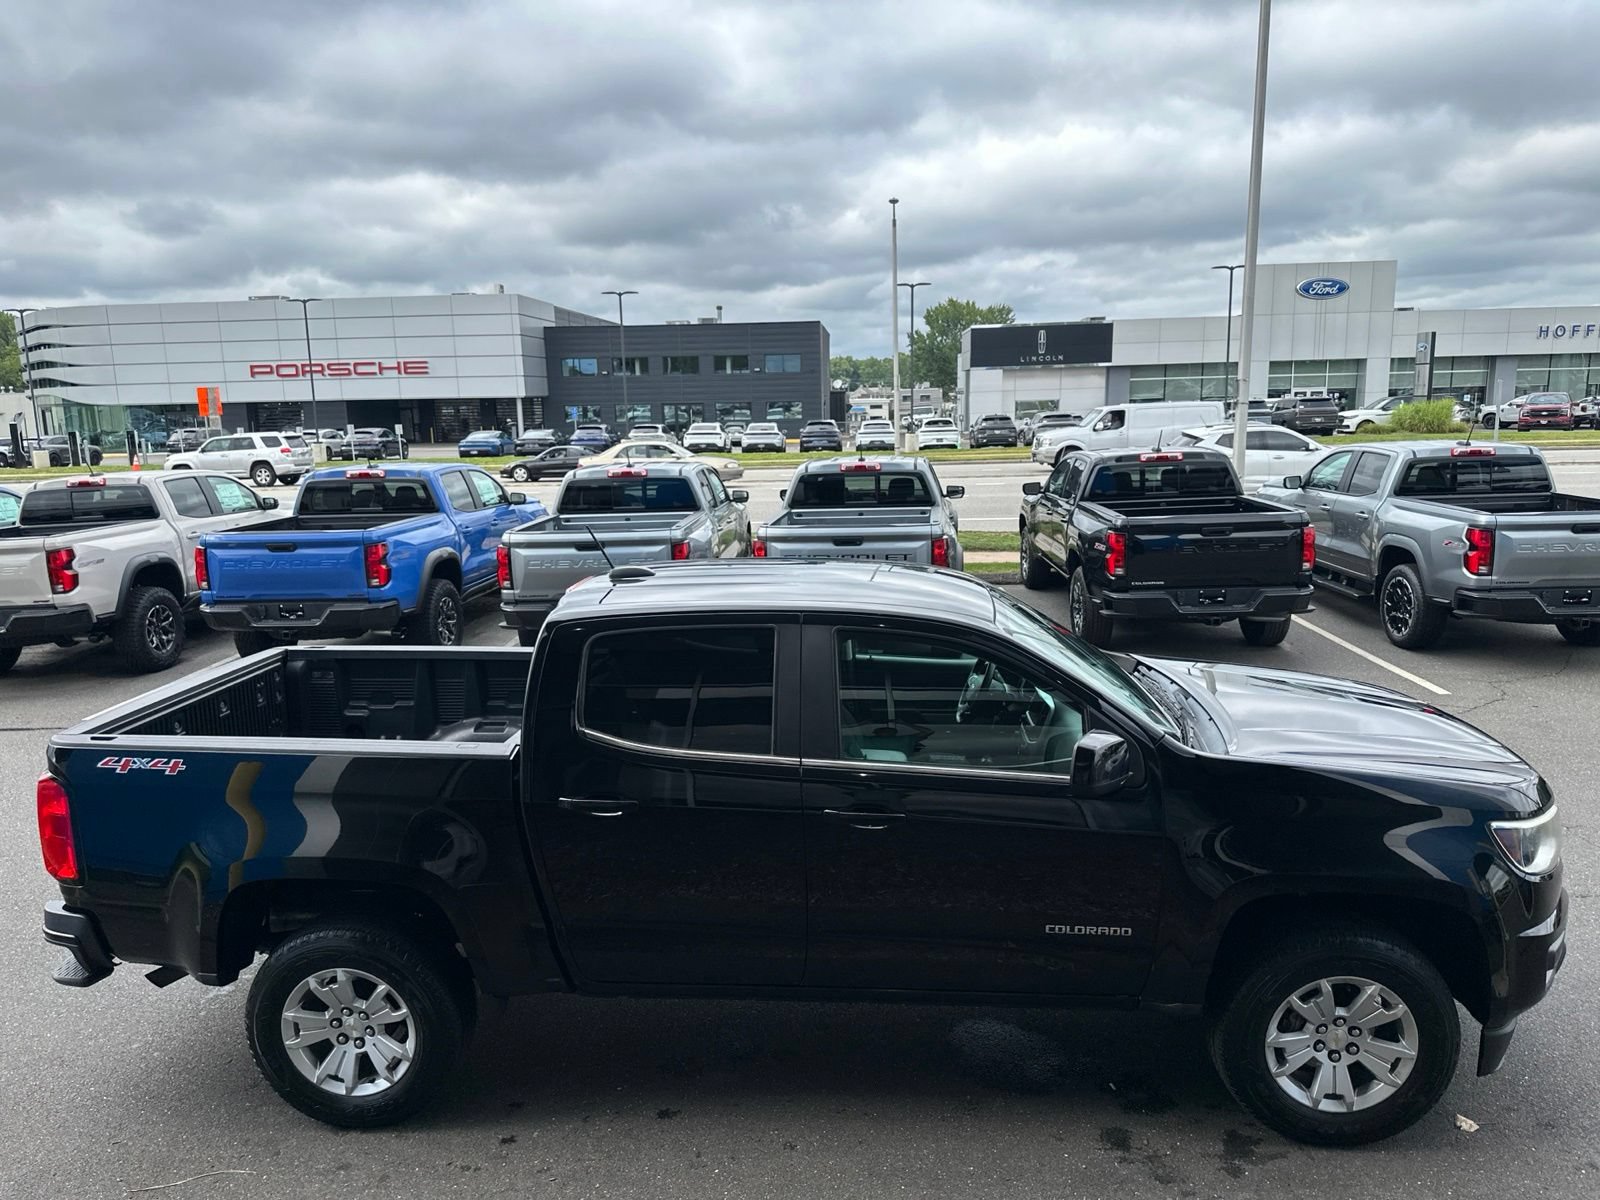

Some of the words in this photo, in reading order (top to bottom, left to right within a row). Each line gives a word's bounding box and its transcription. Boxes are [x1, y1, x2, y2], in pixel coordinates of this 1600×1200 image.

[1308, 281, 1341, 295] Ford
[1538, 324, 1600, 338] HOFF
[1020, 355, 1064, 363] LINCOLN
[249, 360, 430, 379] PORSCHE
[1516, 543, 1600, 553] CHEVR
[223, 559, 348, 570] CHEVROLET
[1045, 924, 1132, 936] COLORADO
